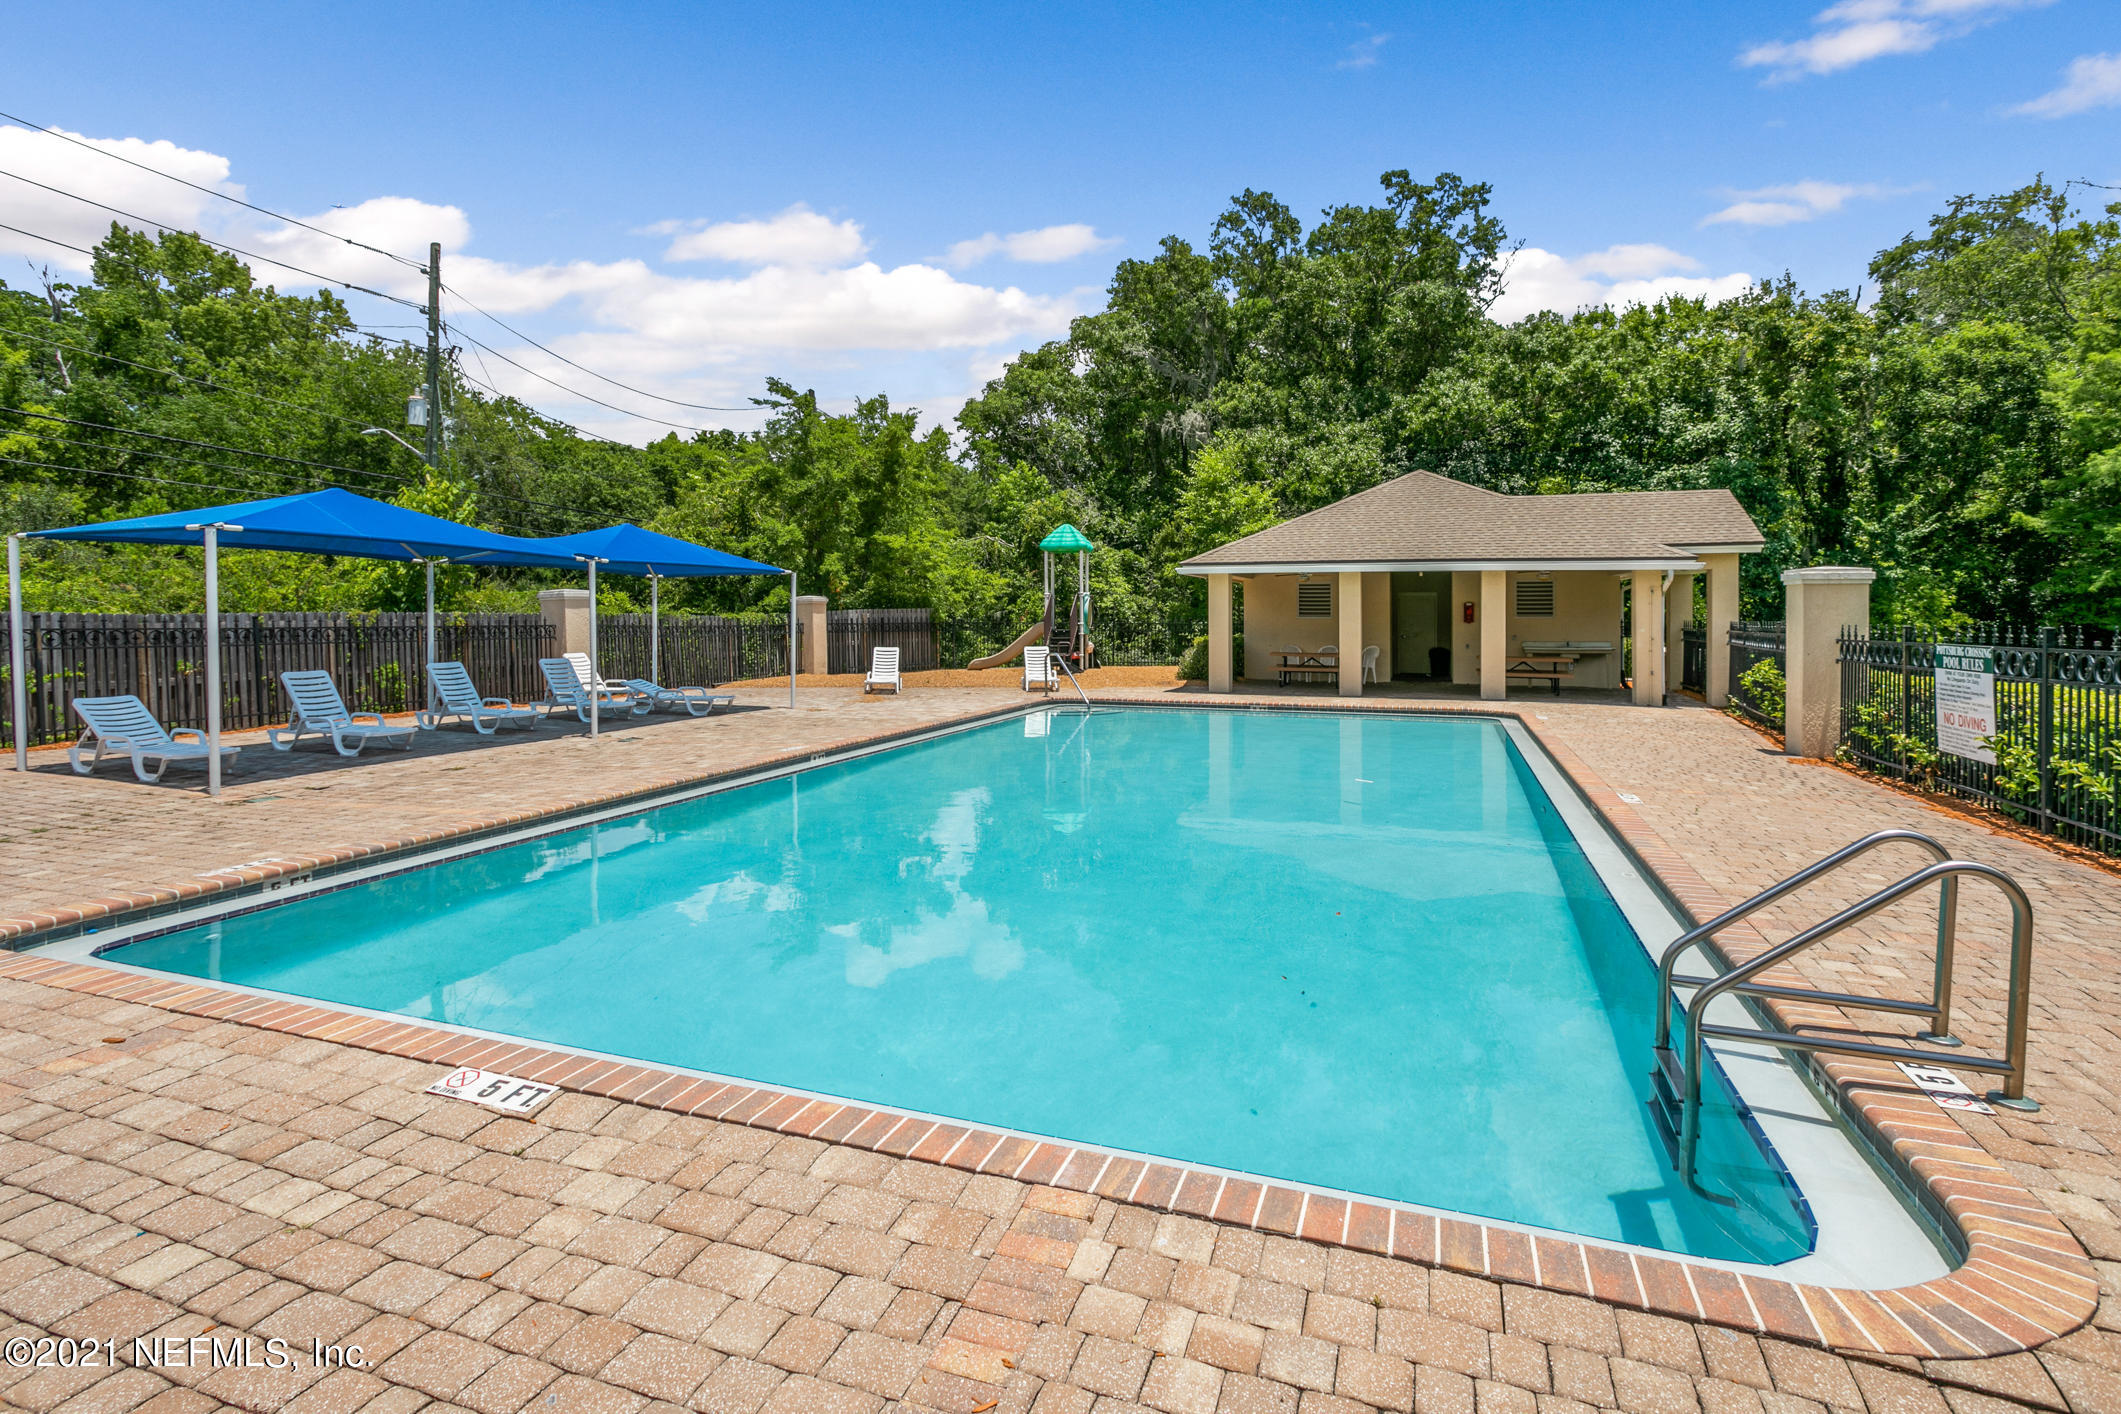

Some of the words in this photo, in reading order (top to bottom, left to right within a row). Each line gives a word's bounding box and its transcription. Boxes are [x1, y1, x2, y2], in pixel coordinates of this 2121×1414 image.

[1965, 647, 1991, 659] CROSSING
[1942, 656, 1960, 669] POOL
[1961, 658, 1984, 672] RULES
[1943, 711, 1955, 726] NO
[1957, 713, 1987, 732] DIVING
[1915, 1073, 1955, 1085] 5
[477, 1079, 511, 1098] 5
